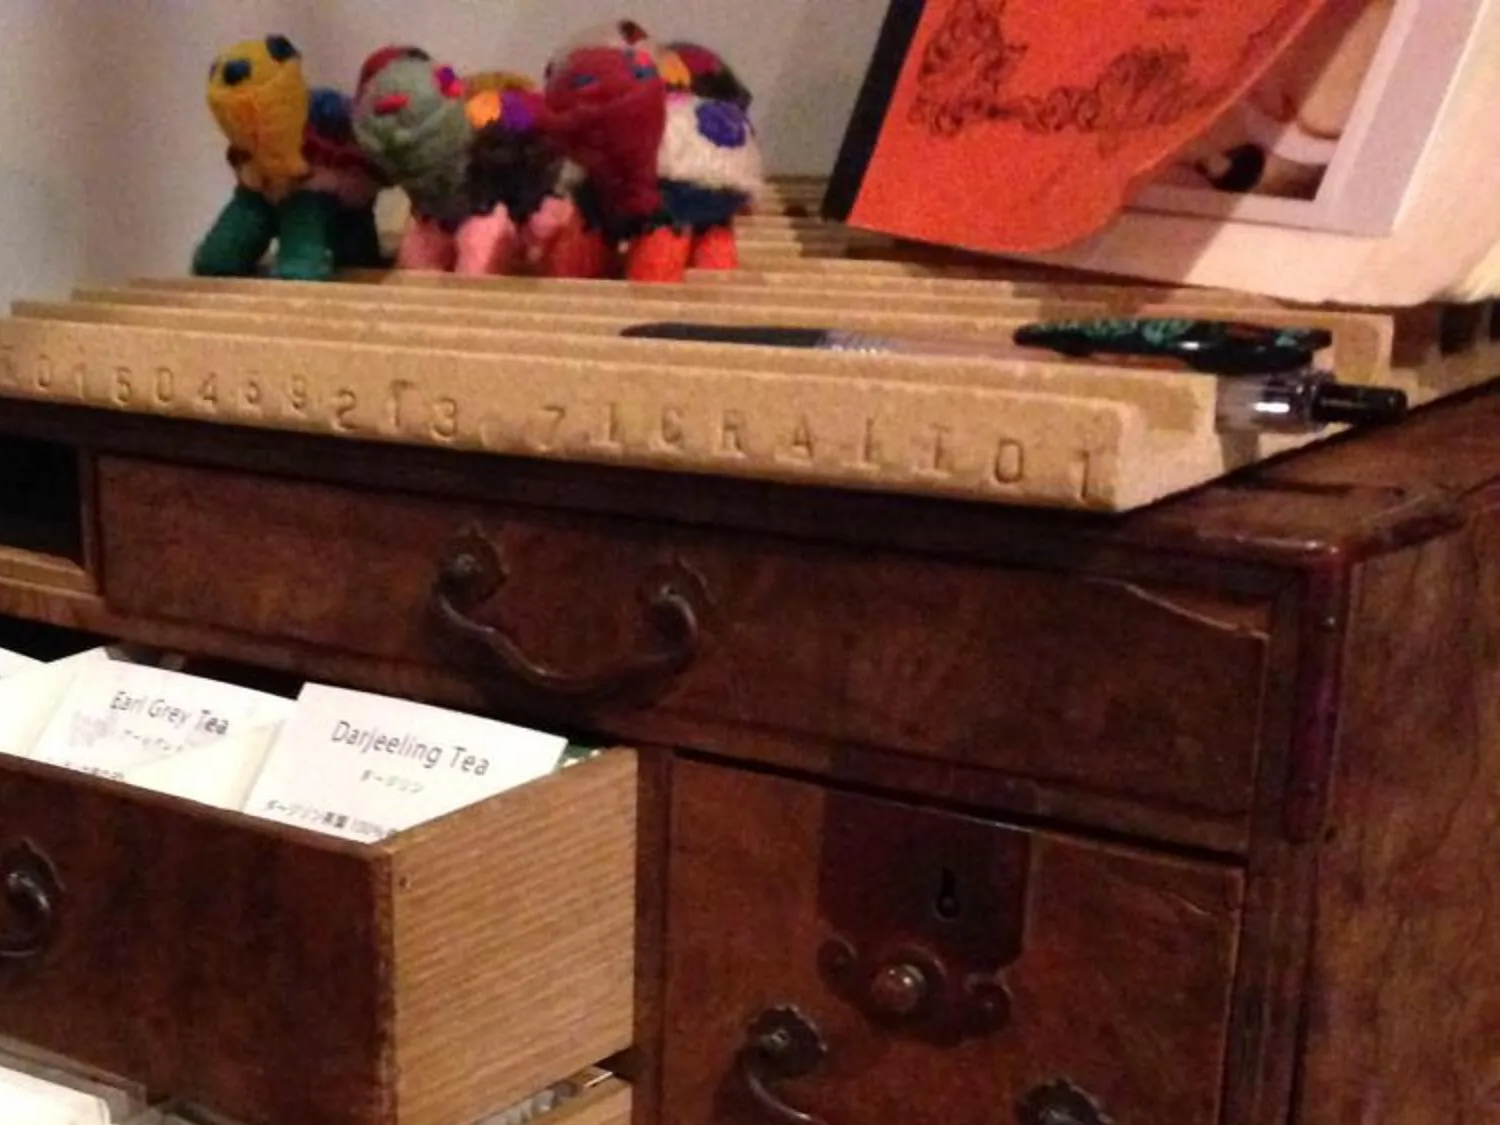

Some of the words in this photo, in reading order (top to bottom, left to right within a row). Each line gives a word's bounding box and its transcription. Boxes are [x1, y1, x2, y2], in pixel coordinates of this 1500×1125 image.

[109, 690, 148, 716] Earl
[147, 697, 192, 731] Grey
[194, 707, 230, 738] Tea
[329, 719, 444, 771] Darjeeling
[447, 744, 491, 778] Tea
